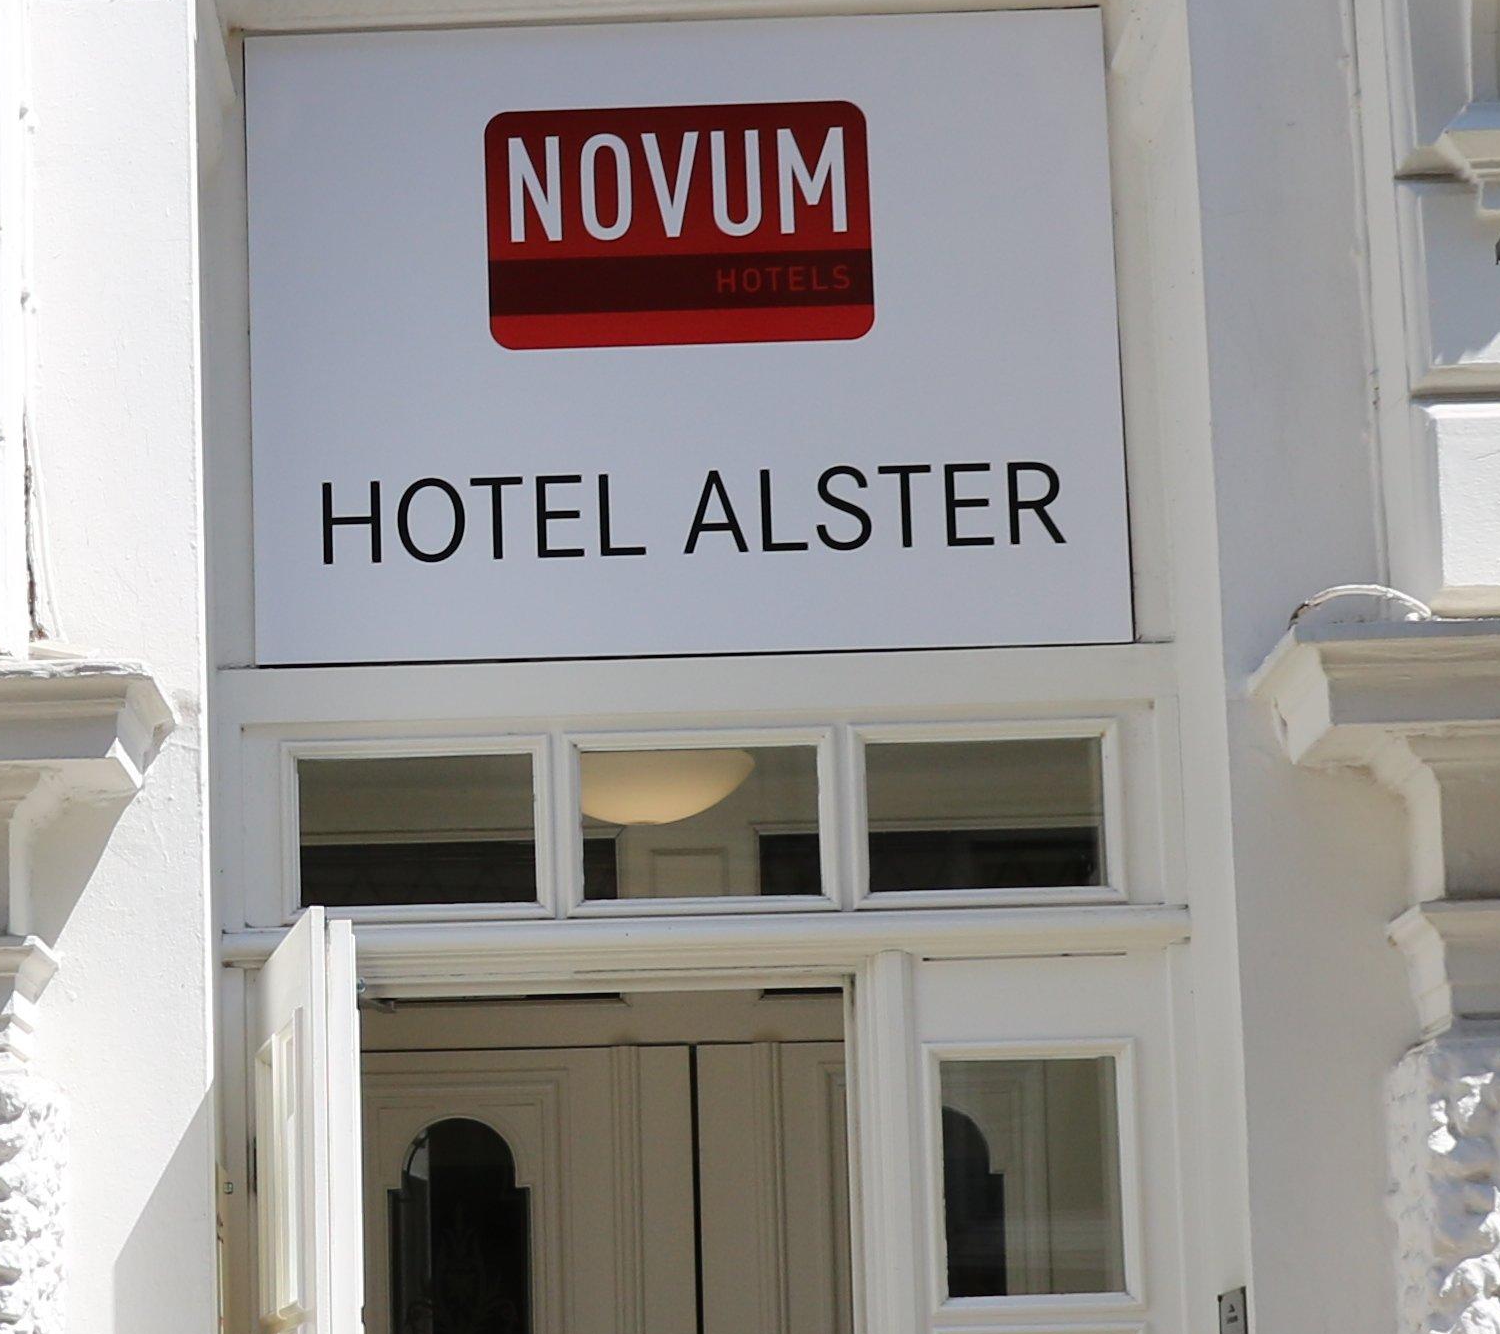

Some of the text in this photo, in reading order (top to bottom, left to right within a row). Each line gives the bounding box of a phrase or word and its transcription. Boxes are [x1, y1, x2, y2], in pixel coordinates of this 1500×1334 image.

[507, 126, 849, 244] NOVUM
[715, 264, 852, 296] HOTELS
[321, 461, 1067, 566] HOTEL ALSTER
